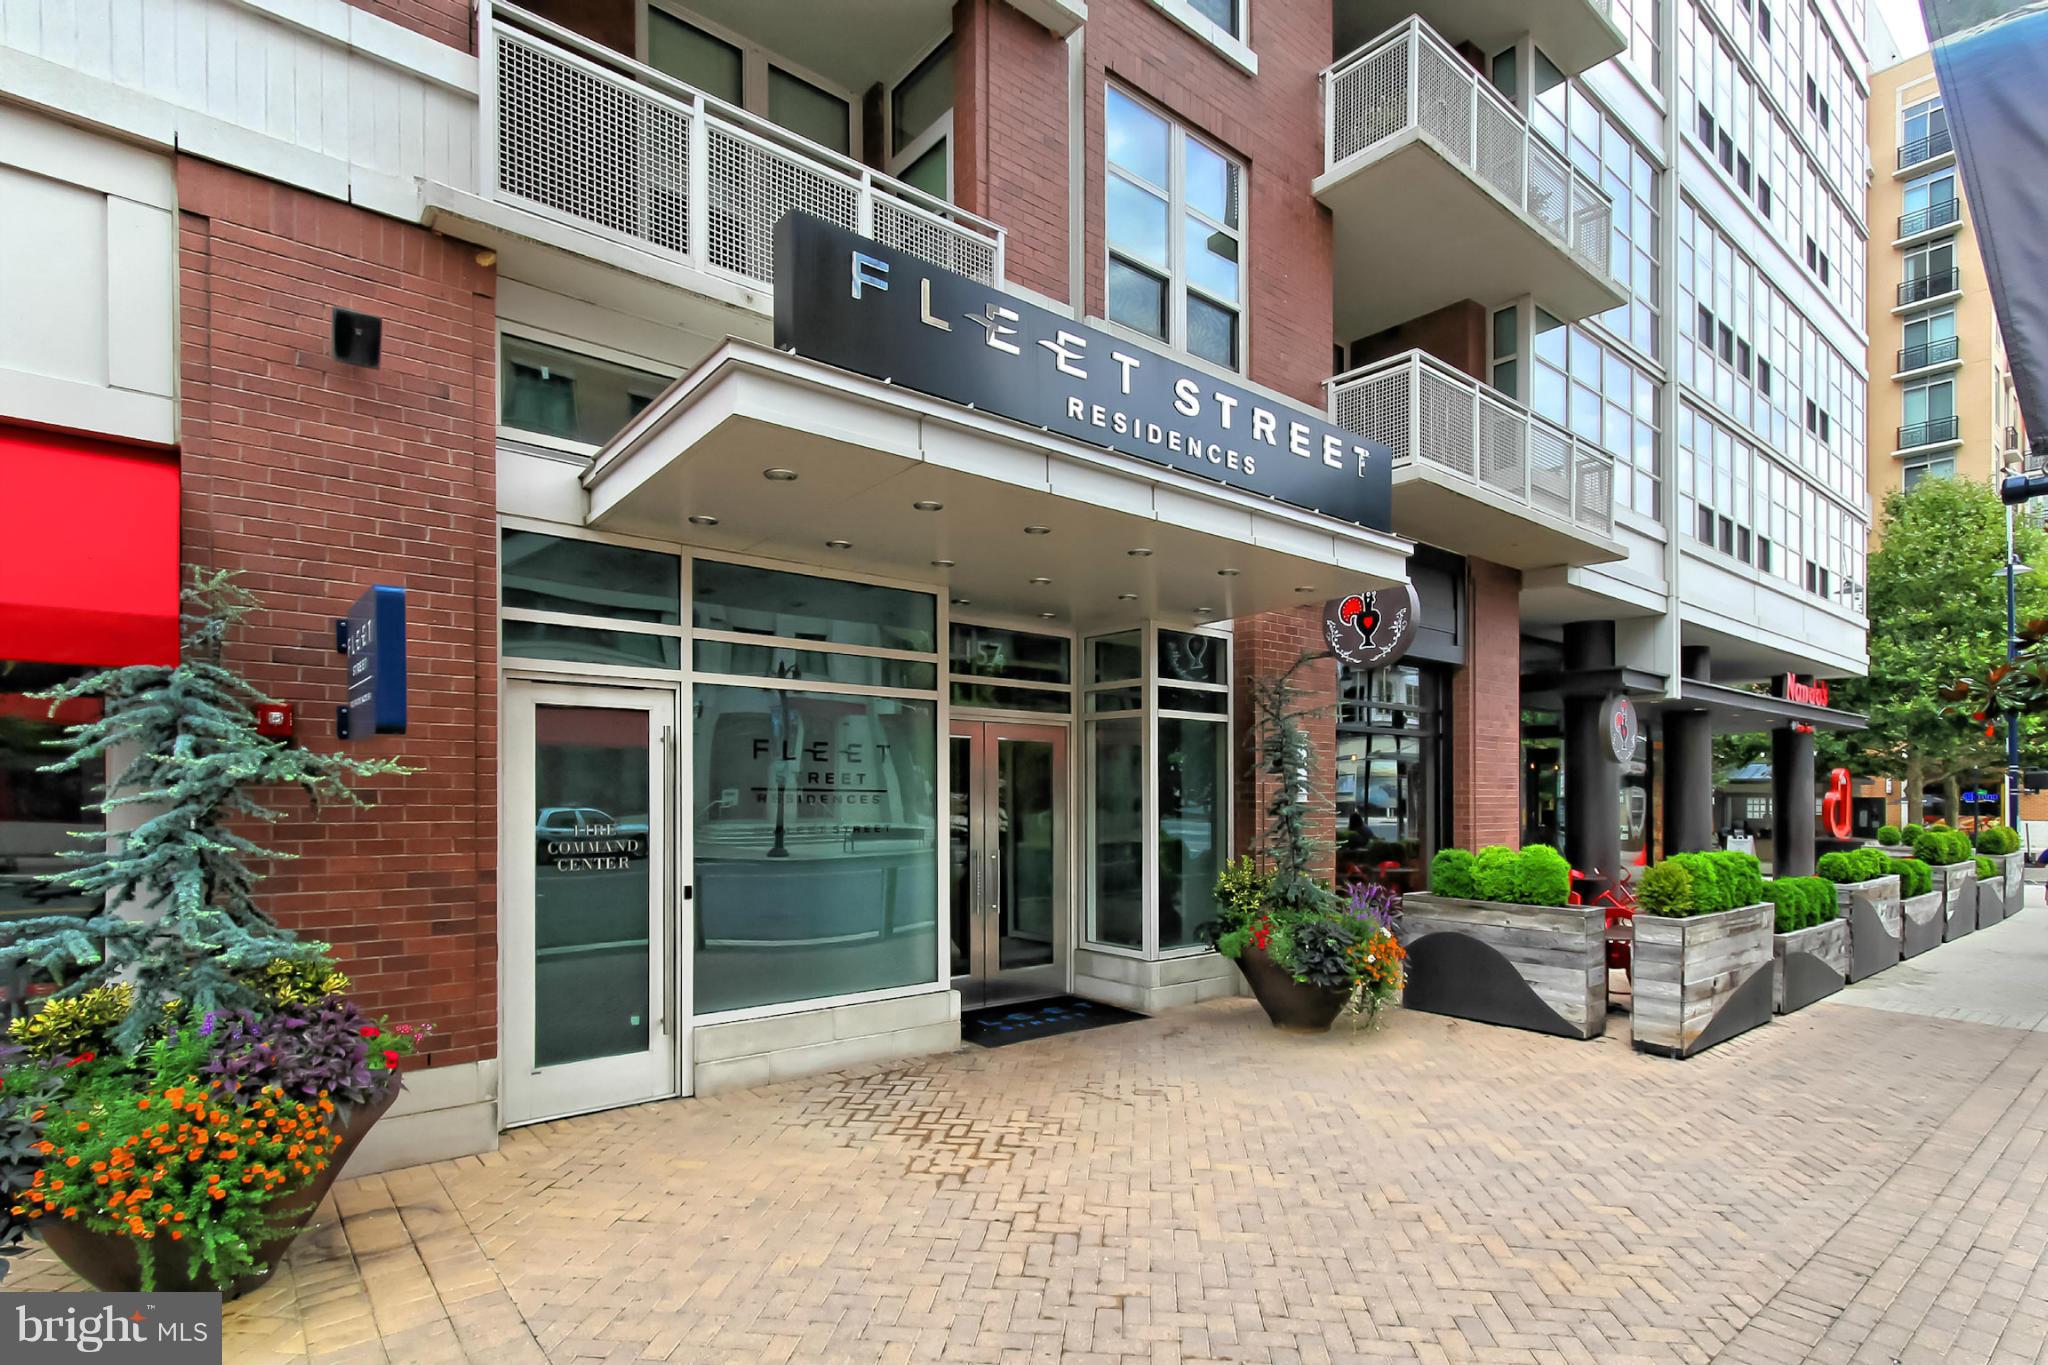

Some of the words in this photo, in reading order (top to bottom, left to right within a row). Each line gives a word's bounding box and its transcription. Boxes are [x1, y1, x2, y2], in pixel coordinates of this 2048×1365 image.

[851, 250, 1140, 395] FLEET
[1173, 378, 1370, 479] STREET
[1067, 397, 1257, 476] RESIDENCES
[347, 619, 372, 656] FLEET
[753, 738, 891, 763] FLEET
[776, 771, 866, 785] SREET
[547, 840, 639, 855] COMMAND
[557, 857, 630, 872] CENTER
